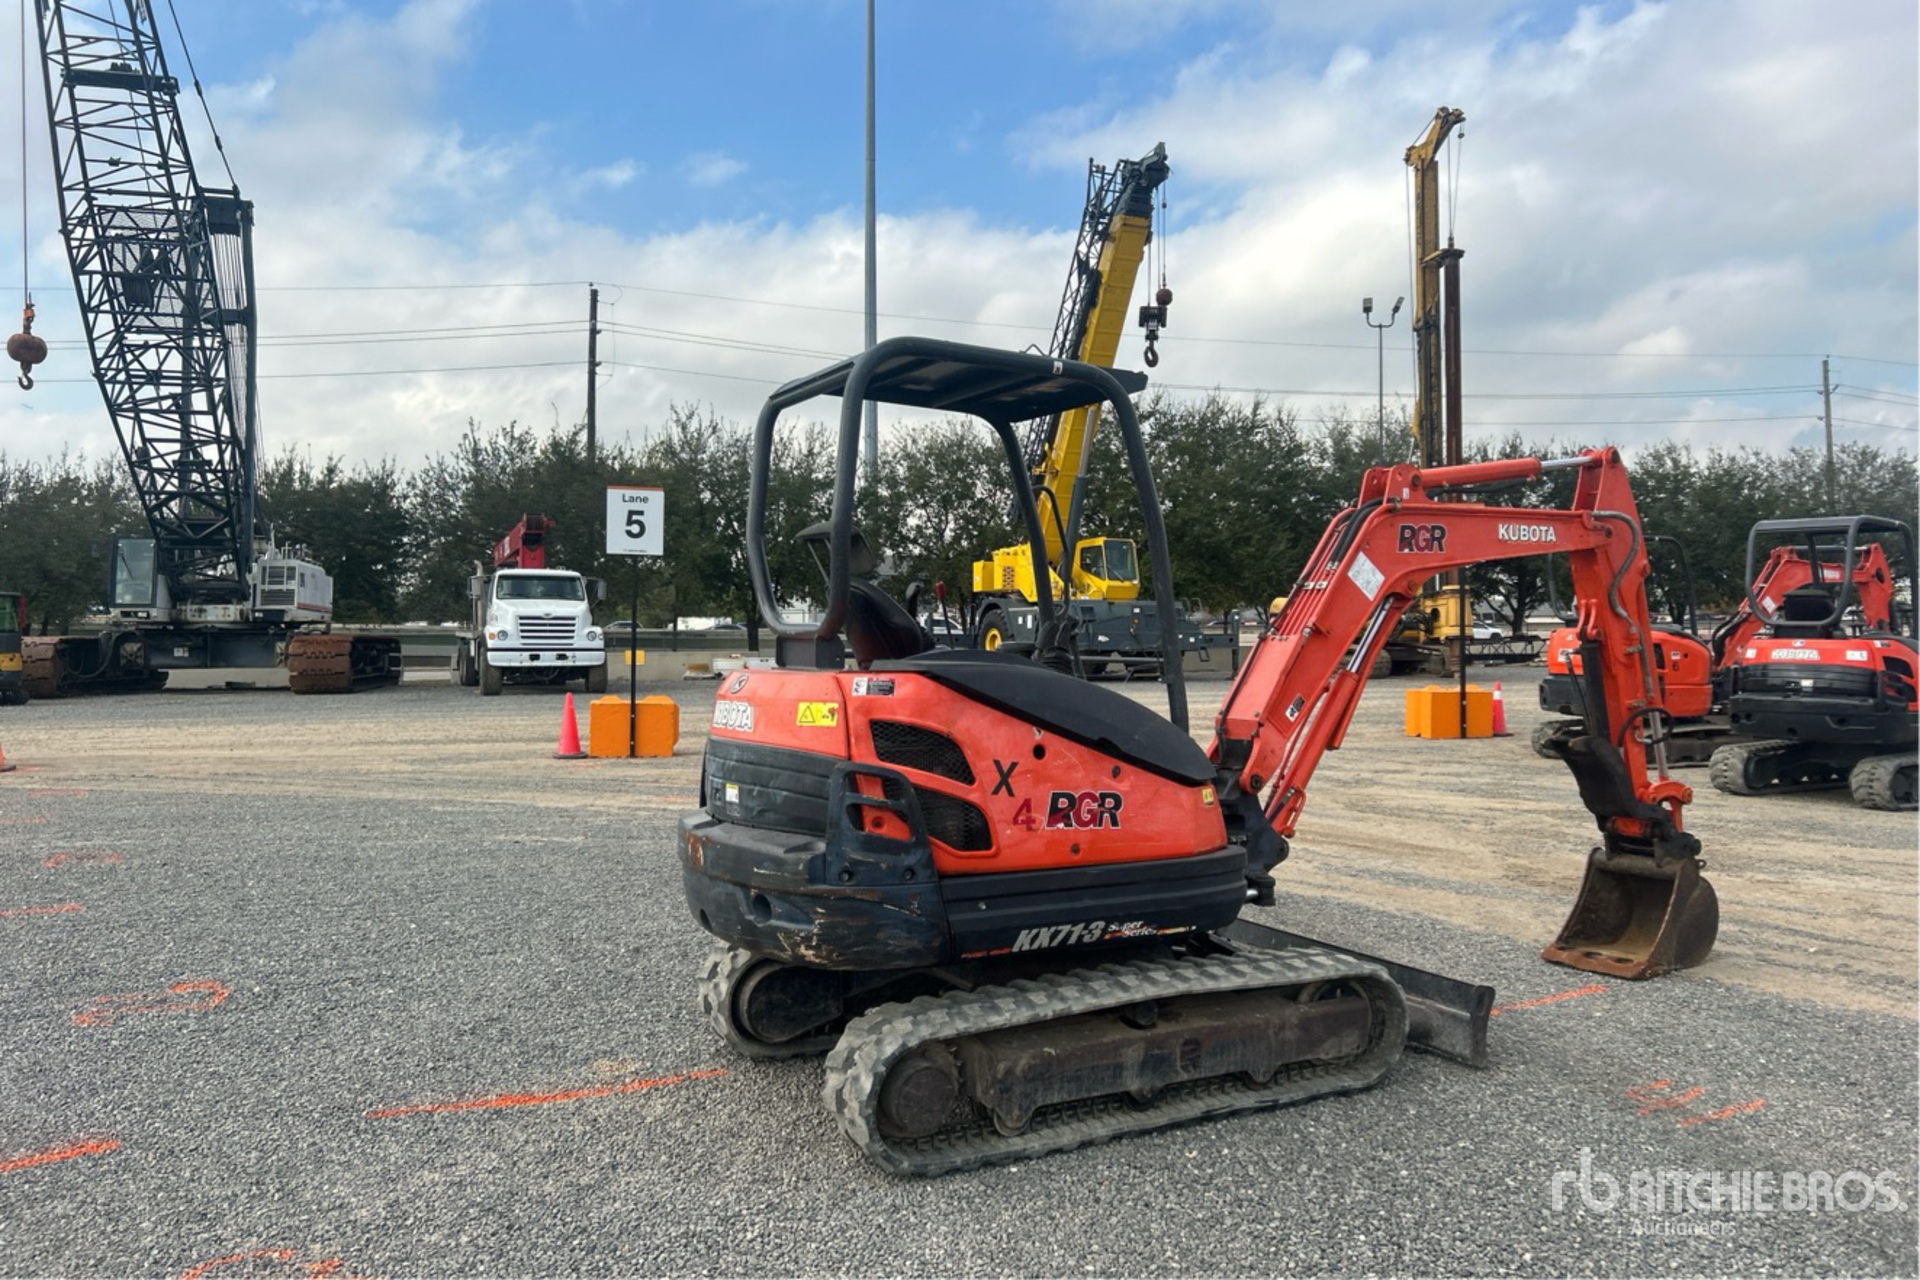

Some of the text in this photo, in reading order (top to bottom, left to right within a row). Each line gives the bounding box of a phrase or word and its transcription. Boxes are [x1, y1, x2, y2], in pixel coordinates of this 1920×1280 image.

[622, 493, 649, 504] Lane
[624, 509, 647, 540] 5
[1397, 523, 1447, 554] RGR
[1498, 522, 1557, 543] KUBOTA
[990, 758, 1019, 798] X
[1012, 797, 1036, 832] 4
[1044, 790, 1123, 830] RGR
[1012, 921, 1106, 952] KX71-3
[1108, 921, 1144, 932] Super
